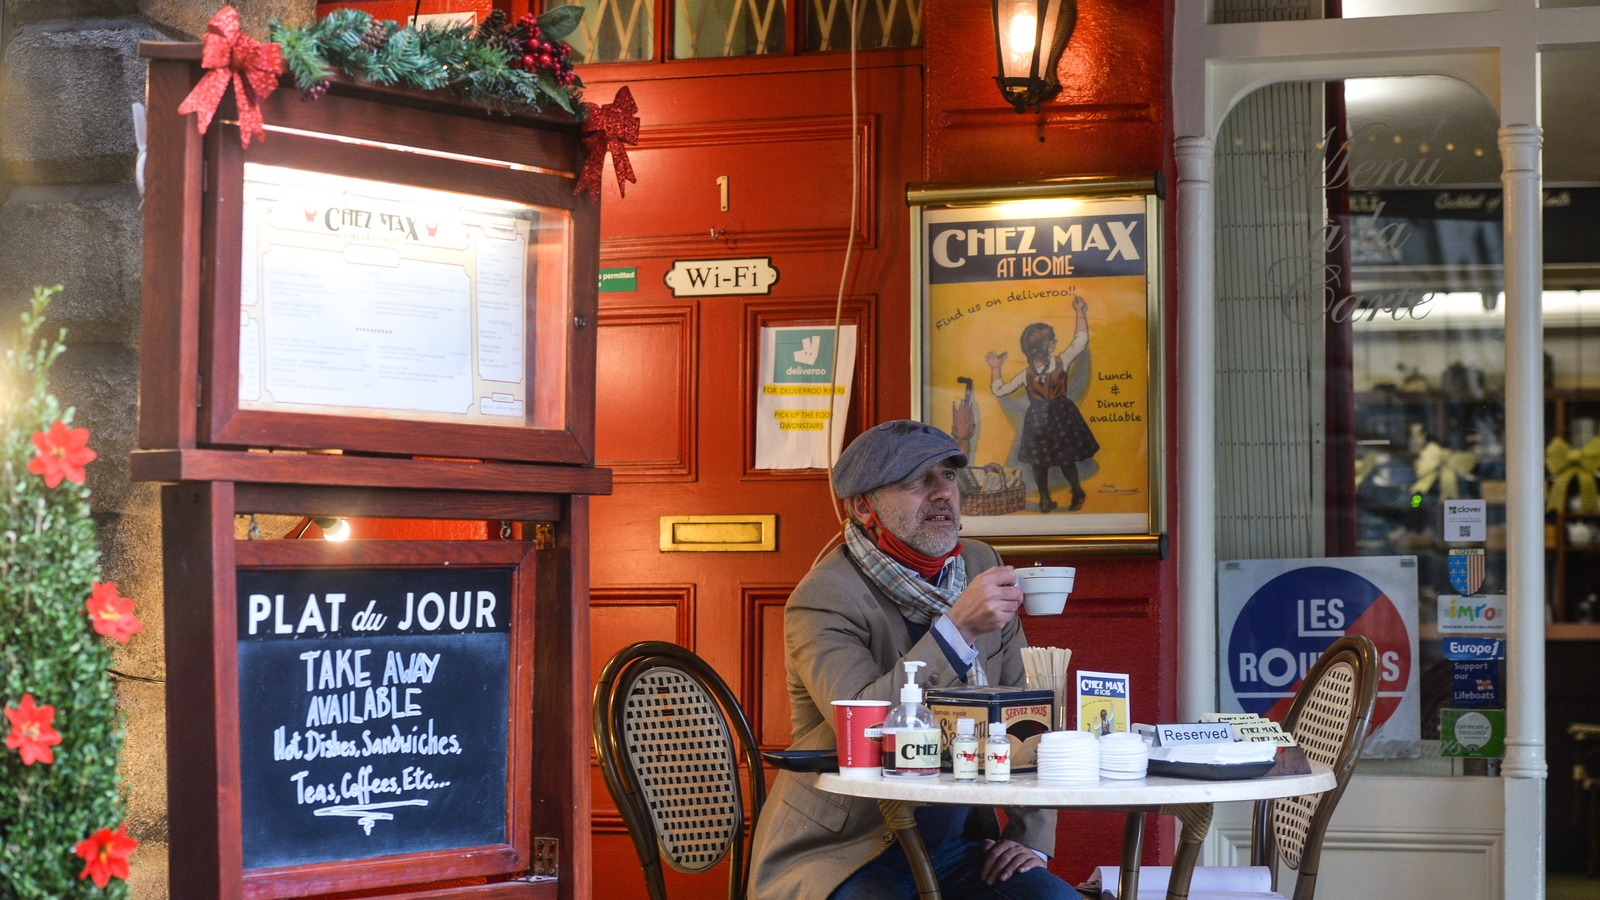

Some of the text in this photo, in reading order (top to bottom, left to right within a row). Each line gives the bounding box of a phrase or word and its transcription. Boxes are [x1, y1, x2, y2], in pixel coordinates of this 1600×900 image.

[1260, 122, 1446, 191] Menu
[716, 175, 729, 211] 1
[324, 207, 419, 241] CHEZ MAX
[1356, 201, 1411, 251] la
[932, 221, 1140, 268] CHEZ MAX
[602, 272, 635, 281] permitted
[997, 255, 1074, 278] AT HOME
[685, 265, 758, 289] Wi-Fi
[1268, 256, 1436, 325] Carte
[935, 286, 1076, 331] Find us on deliveroo!!
[786, 366, 827, 376] deliveroo
[1098, 371, 1133, 381] Lunch
[763, 386, 777, 394] FOR
[1110, 384, 1121, 395] &
[1096, 400, 1135, 408] Dinner
[774, 411, 789, 419] PICK
[801, 411, 814, 419] THE
[816, 411, 833, 419] FOO
[1089, 412, 1142, 423] available
[1457, 505, 1482, 513] clover
[248, 590, 496, 635] PLAT du JOUR
[1297, 598, 1345, 637] LES
[1450, 599, 1496, 622] imro
[299, 648, 441, 692] TAKE AWAY
[1454, 663, 1489, 671] Support
[1081, 679, 1125, 694] CHEZ MAX
[1454, 691, 1495, 700] Lifeboats
[306, 686, 423, 728] AVAILABLE
[1005, 706, 1047, 720] SERVEZ VOUS
[362, 719, 463, 757] Sandwiches,
[1163, 728, 1229, 742] Reserved
[1240, 726, 1279, 735] CHEZ MAX
[900, 743, 939, 760] CHEZ
[290, 771, 341, 805] Teas,
[340, 765, 403, 805] Coffees,
